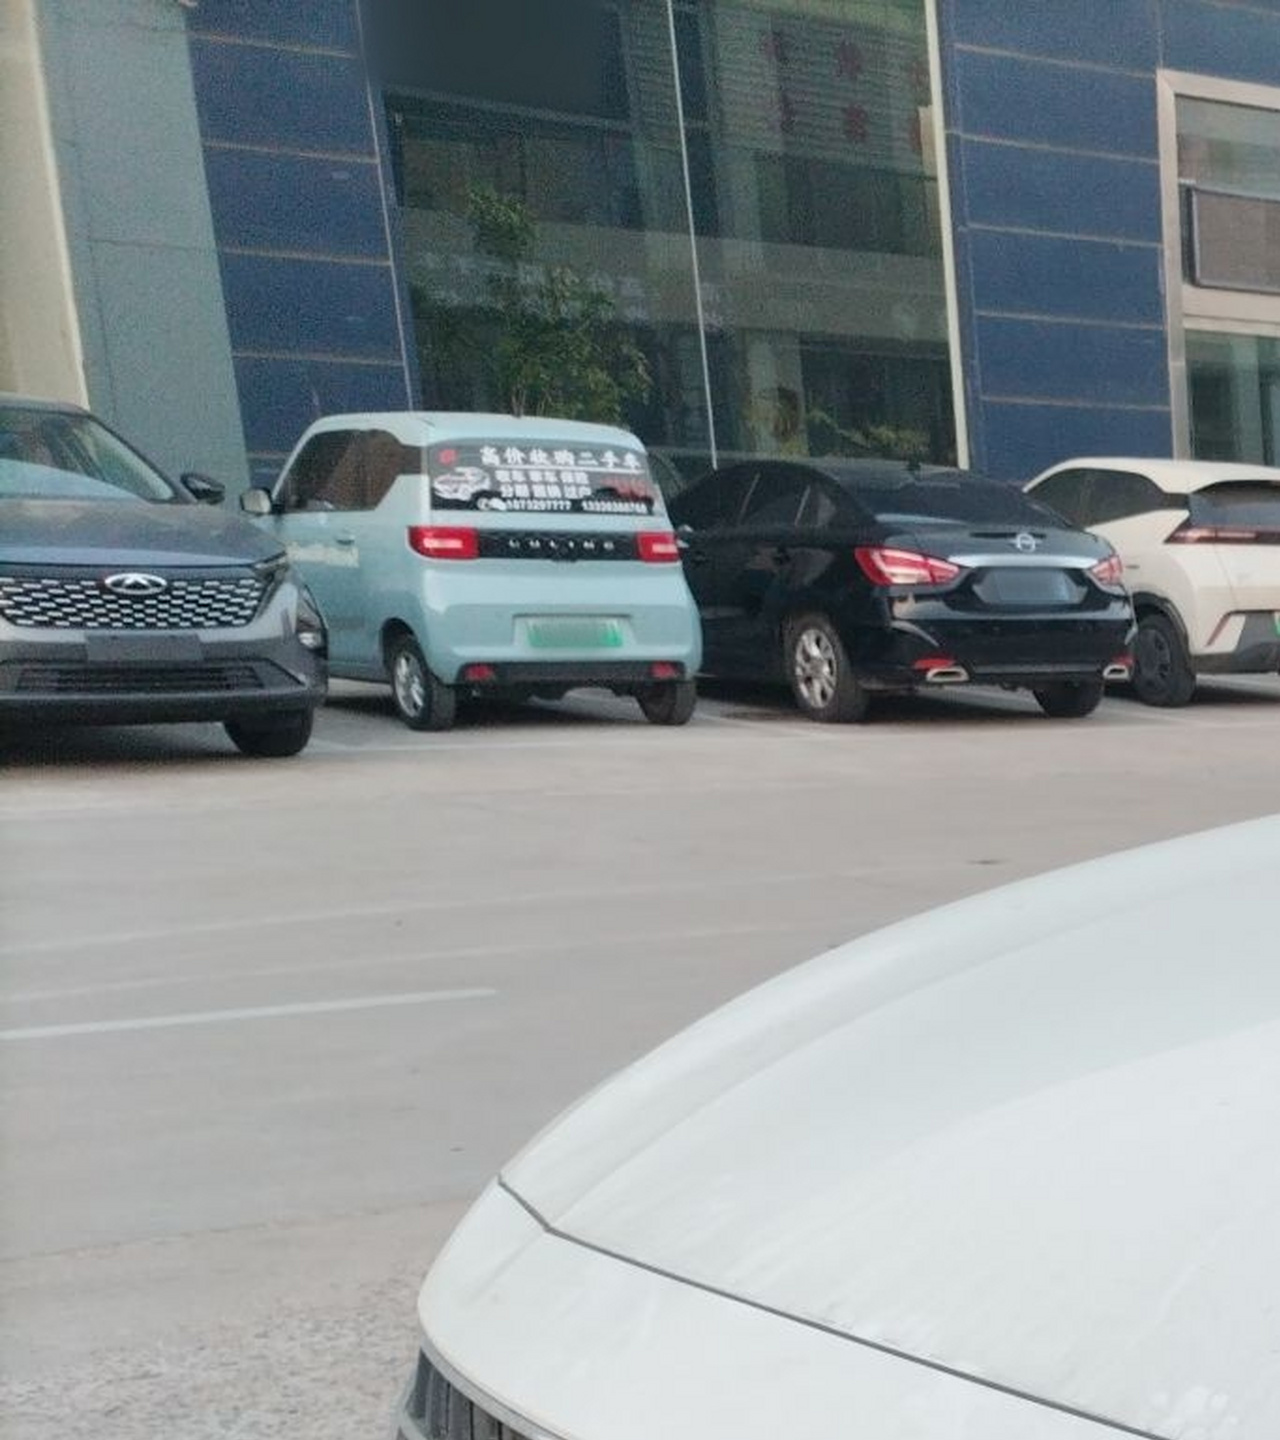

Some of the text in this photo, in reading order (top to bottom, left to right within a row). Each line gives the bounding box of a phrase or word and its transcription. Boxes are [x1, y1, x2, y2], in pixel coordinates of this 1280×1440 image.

[480, 446, 642, 469] 高价收购二手车
